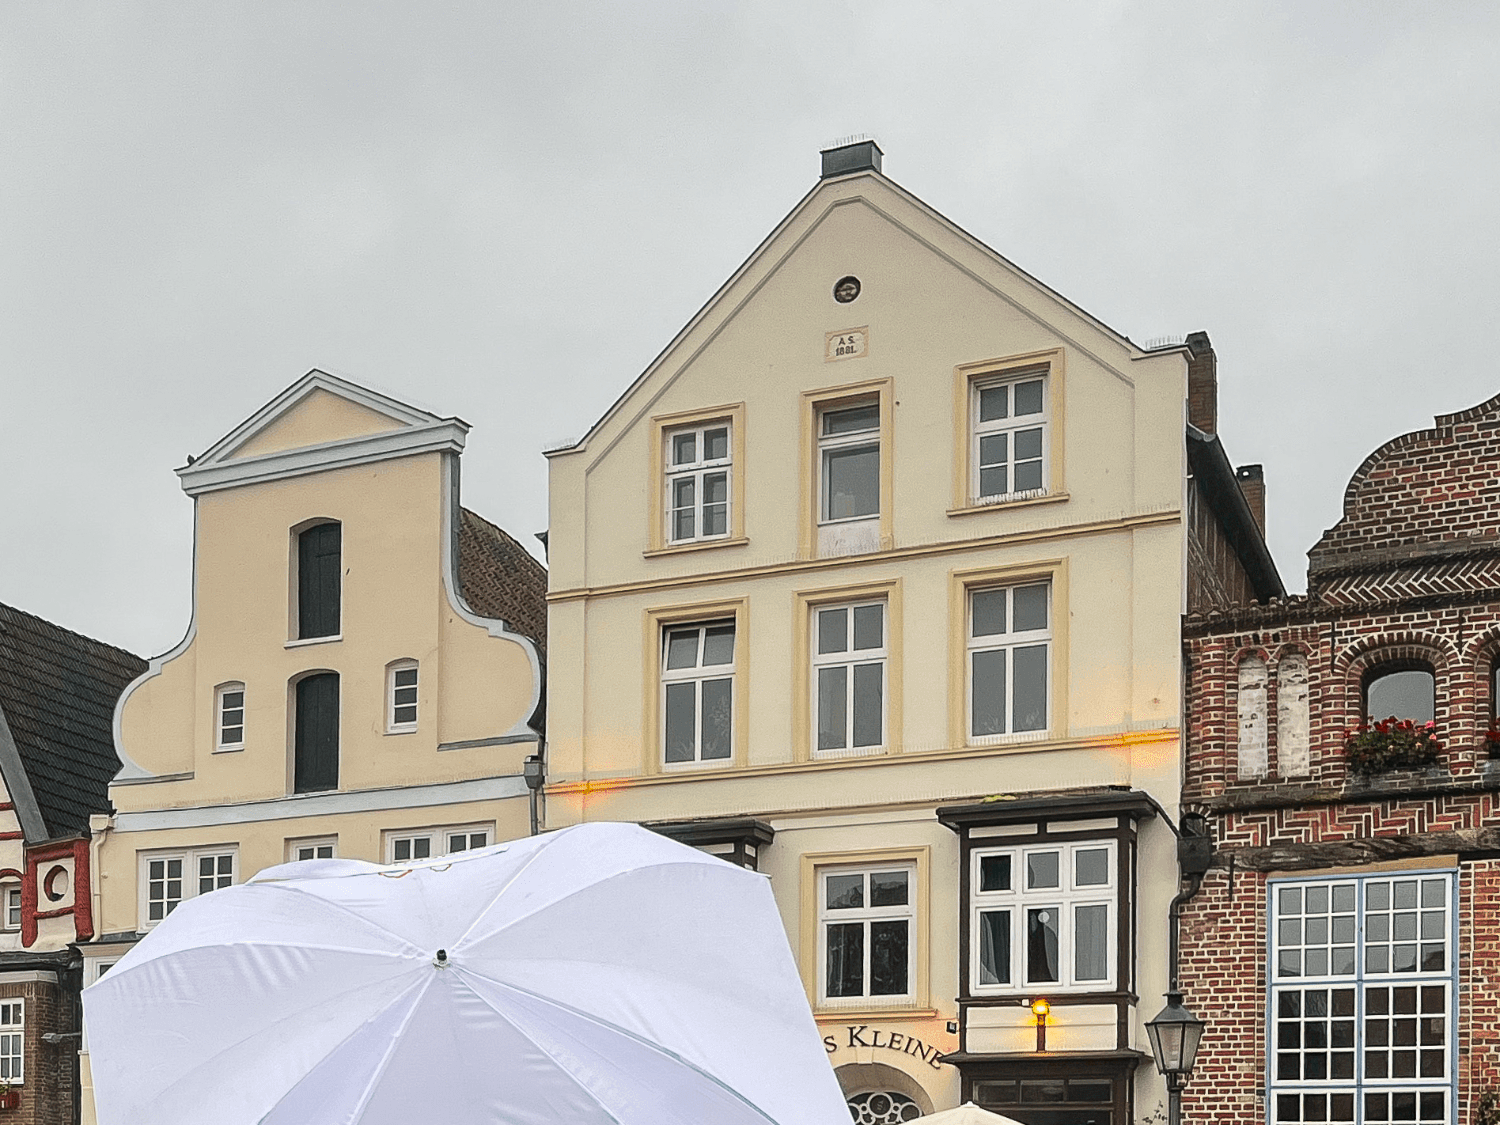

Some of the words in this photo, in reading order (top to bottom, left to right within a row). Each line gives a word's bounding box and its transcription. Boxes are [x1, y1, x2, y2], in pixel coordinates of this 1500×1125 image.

[839, 337, 846, 345] A
[822, 1034, 838, 1054] S
[846, 1025, 944, 1070] KLEINE
